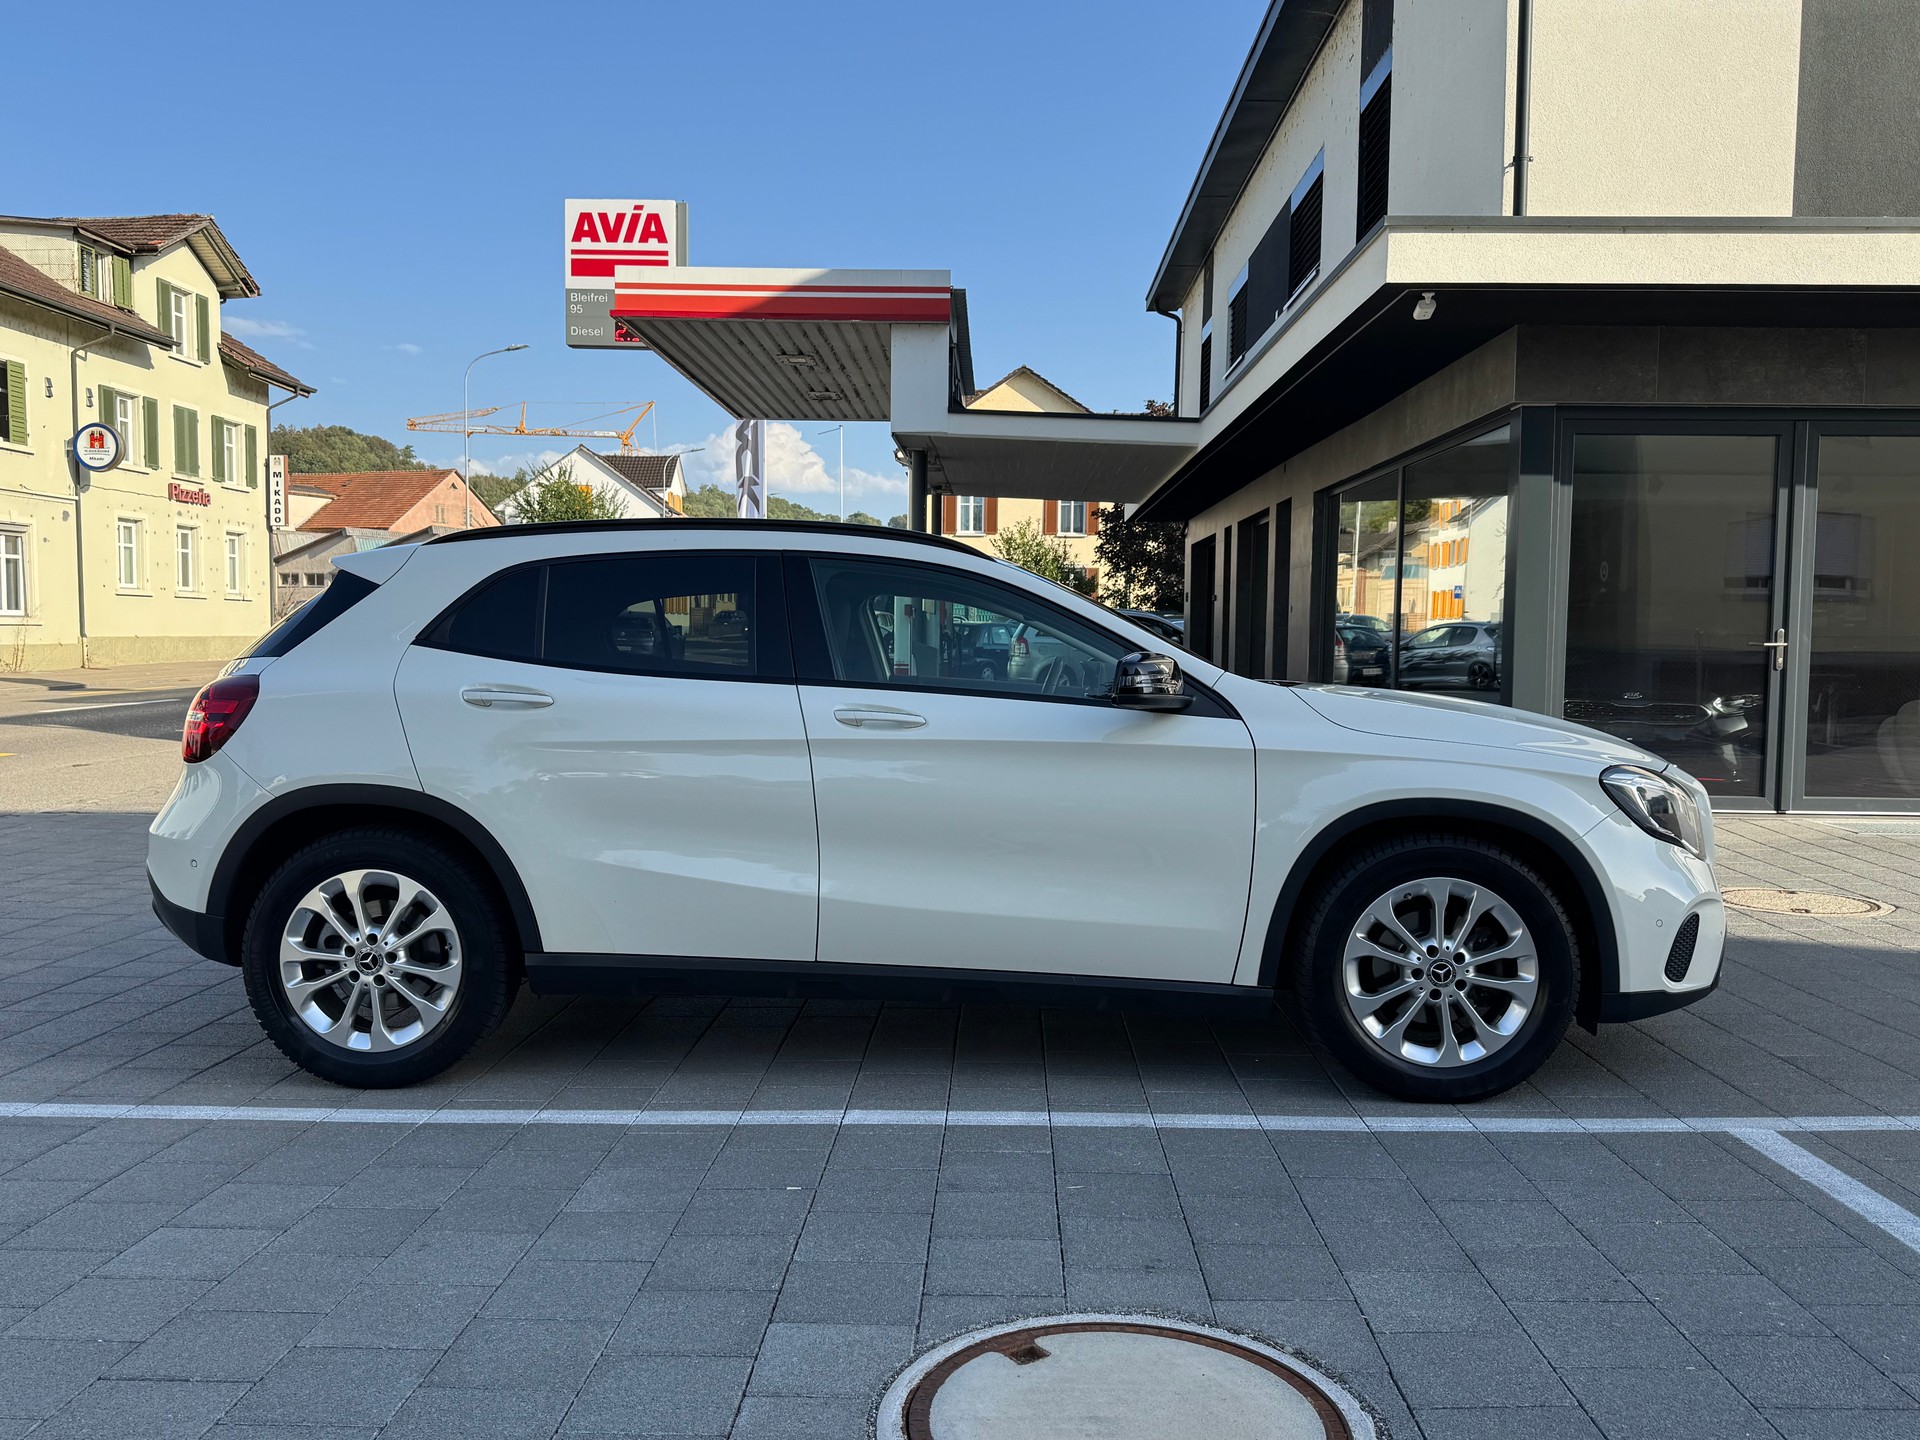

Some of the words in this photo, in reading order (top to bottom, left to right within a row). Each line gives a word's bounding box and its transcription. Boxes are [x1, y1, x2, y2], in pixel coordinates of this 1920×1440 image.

[570, 293, 608, 302] Bleifrei
[570, 304, 583, 314] 95
[570, 326, 604, 336] Diesel
[169, 483, 211, 506] Pizzeria
[272, 471, 282, 524] MIKADO
